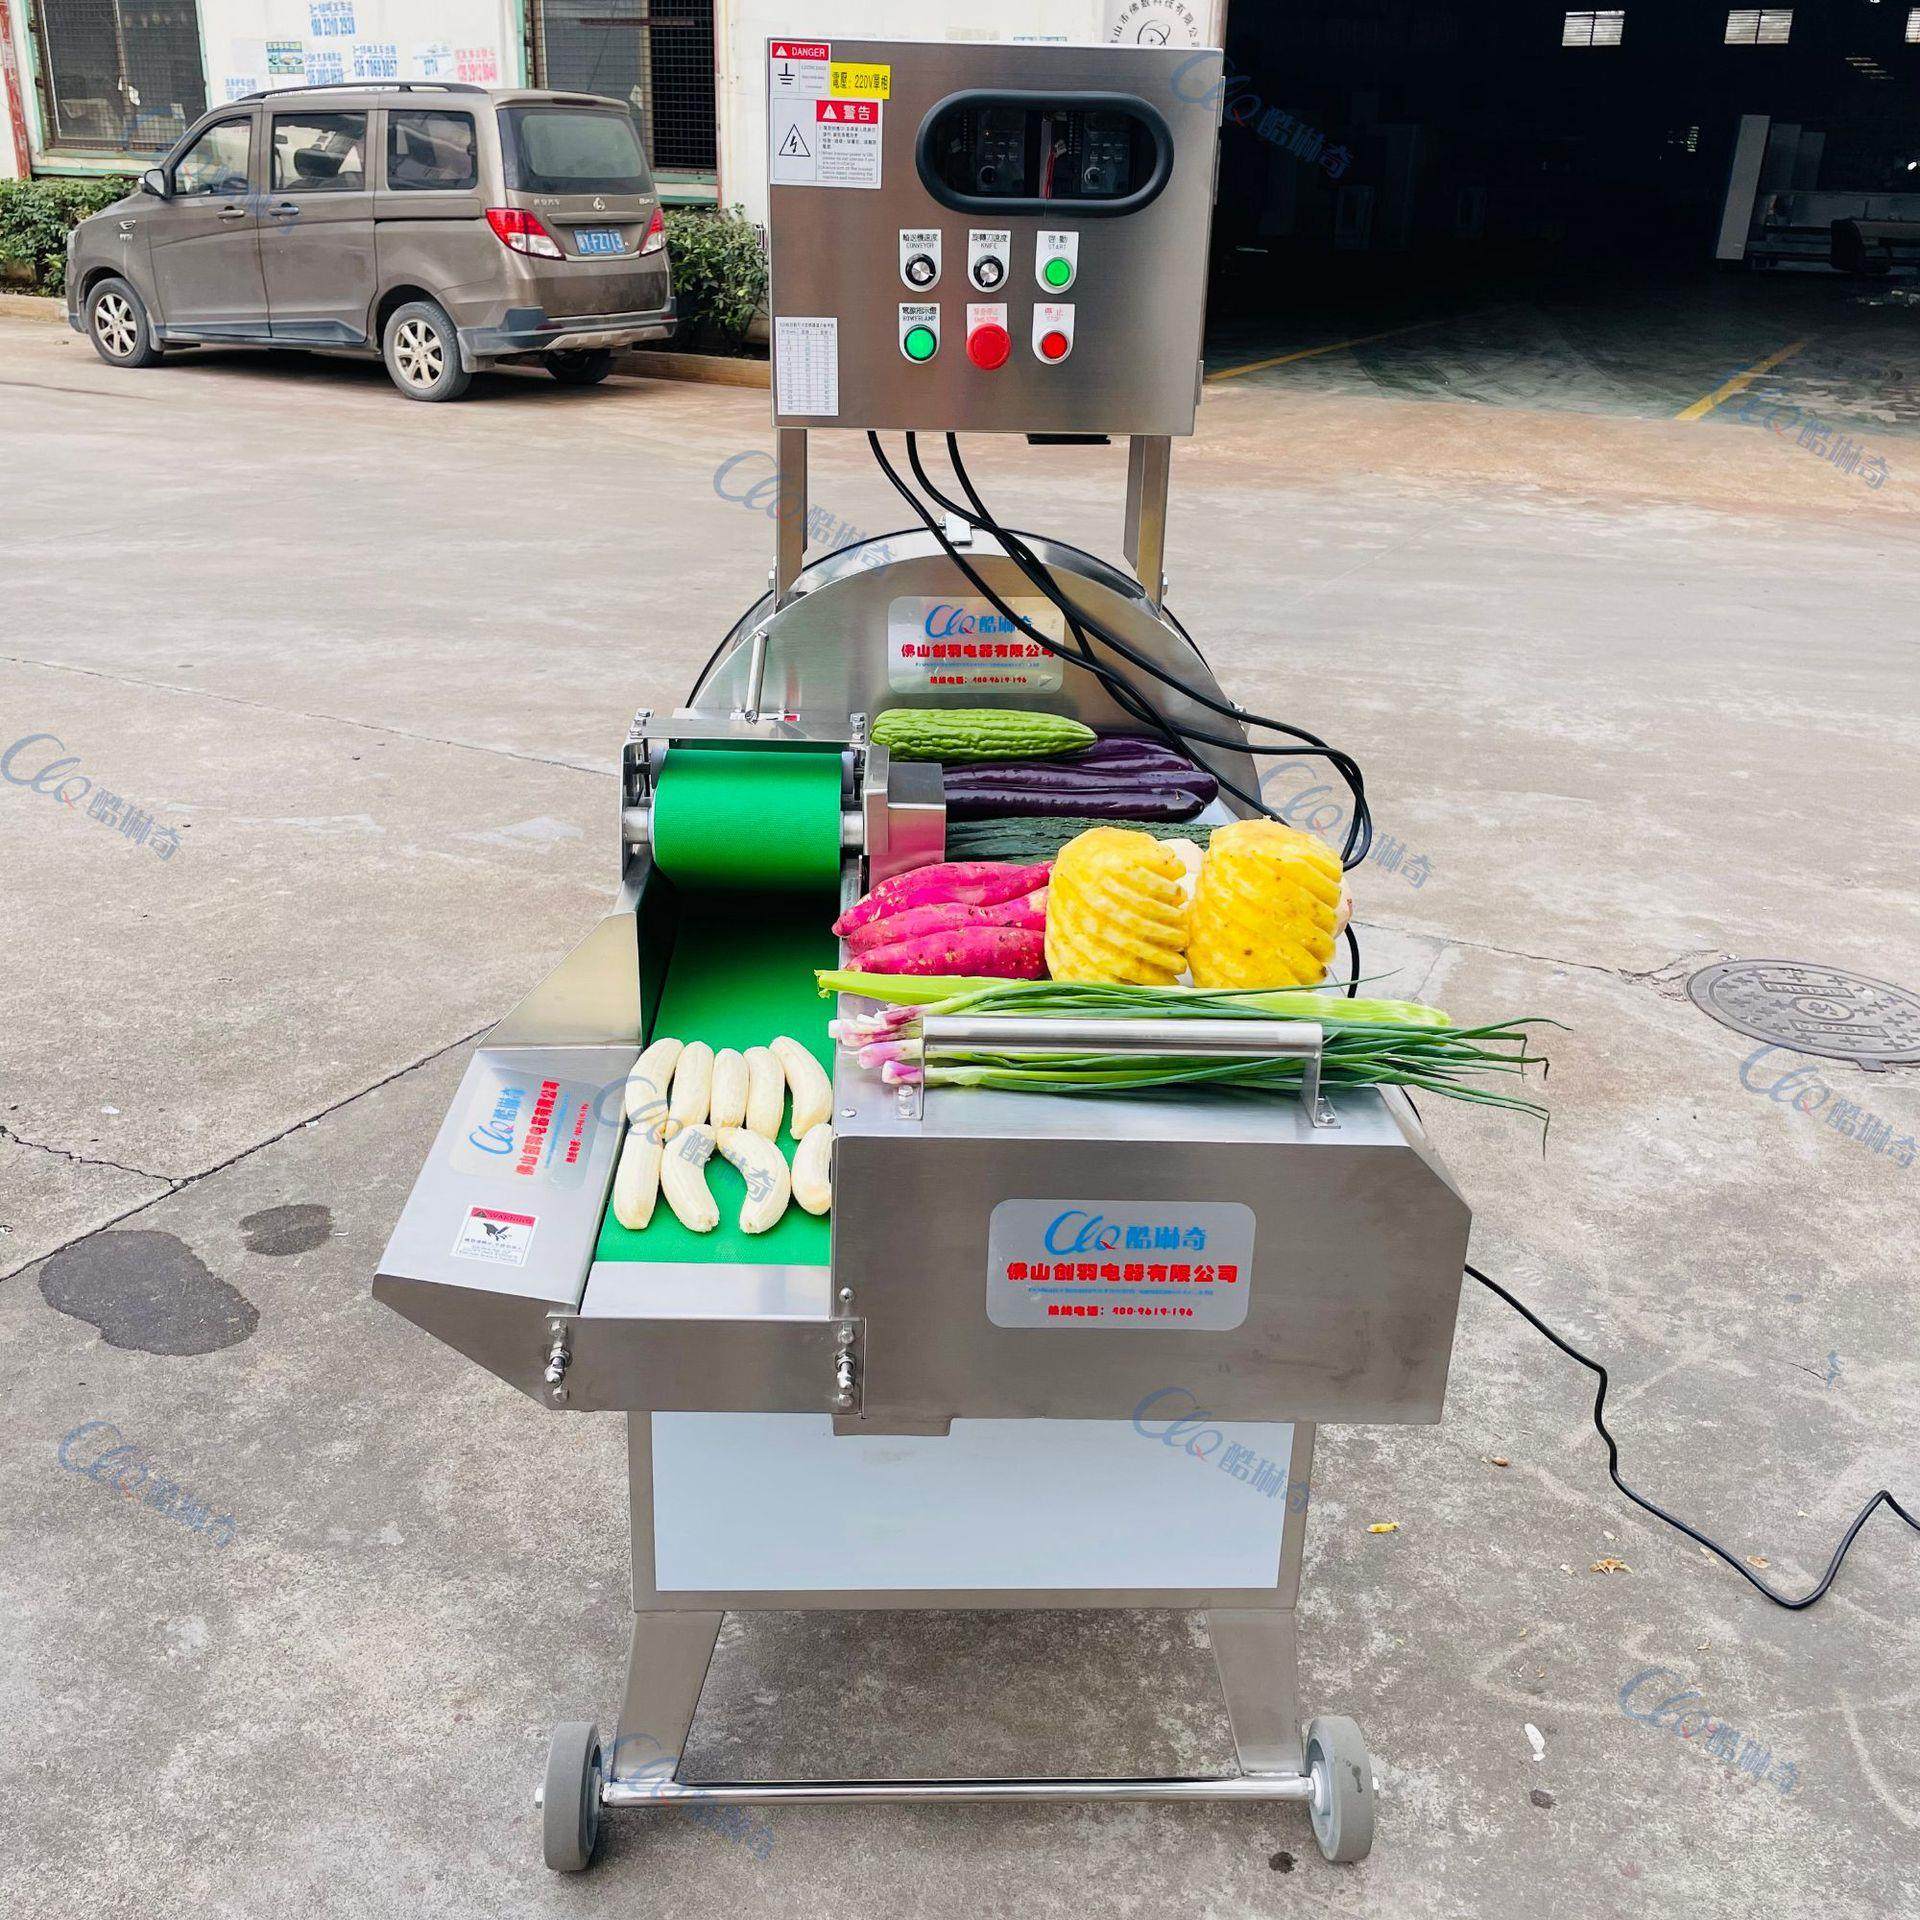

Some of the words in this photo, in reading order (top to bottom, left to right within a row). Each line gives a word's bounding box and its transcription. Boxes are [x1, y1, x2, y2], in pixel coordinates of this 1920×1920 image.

[791, 46, 826, 57] DANGER
[843, 104, 871, 120] 警告
[1125, 1225, 1207, 1252] 酷琳奇
[1006, 1262, 1239, 1284] 佛山创羽电器有限公司
